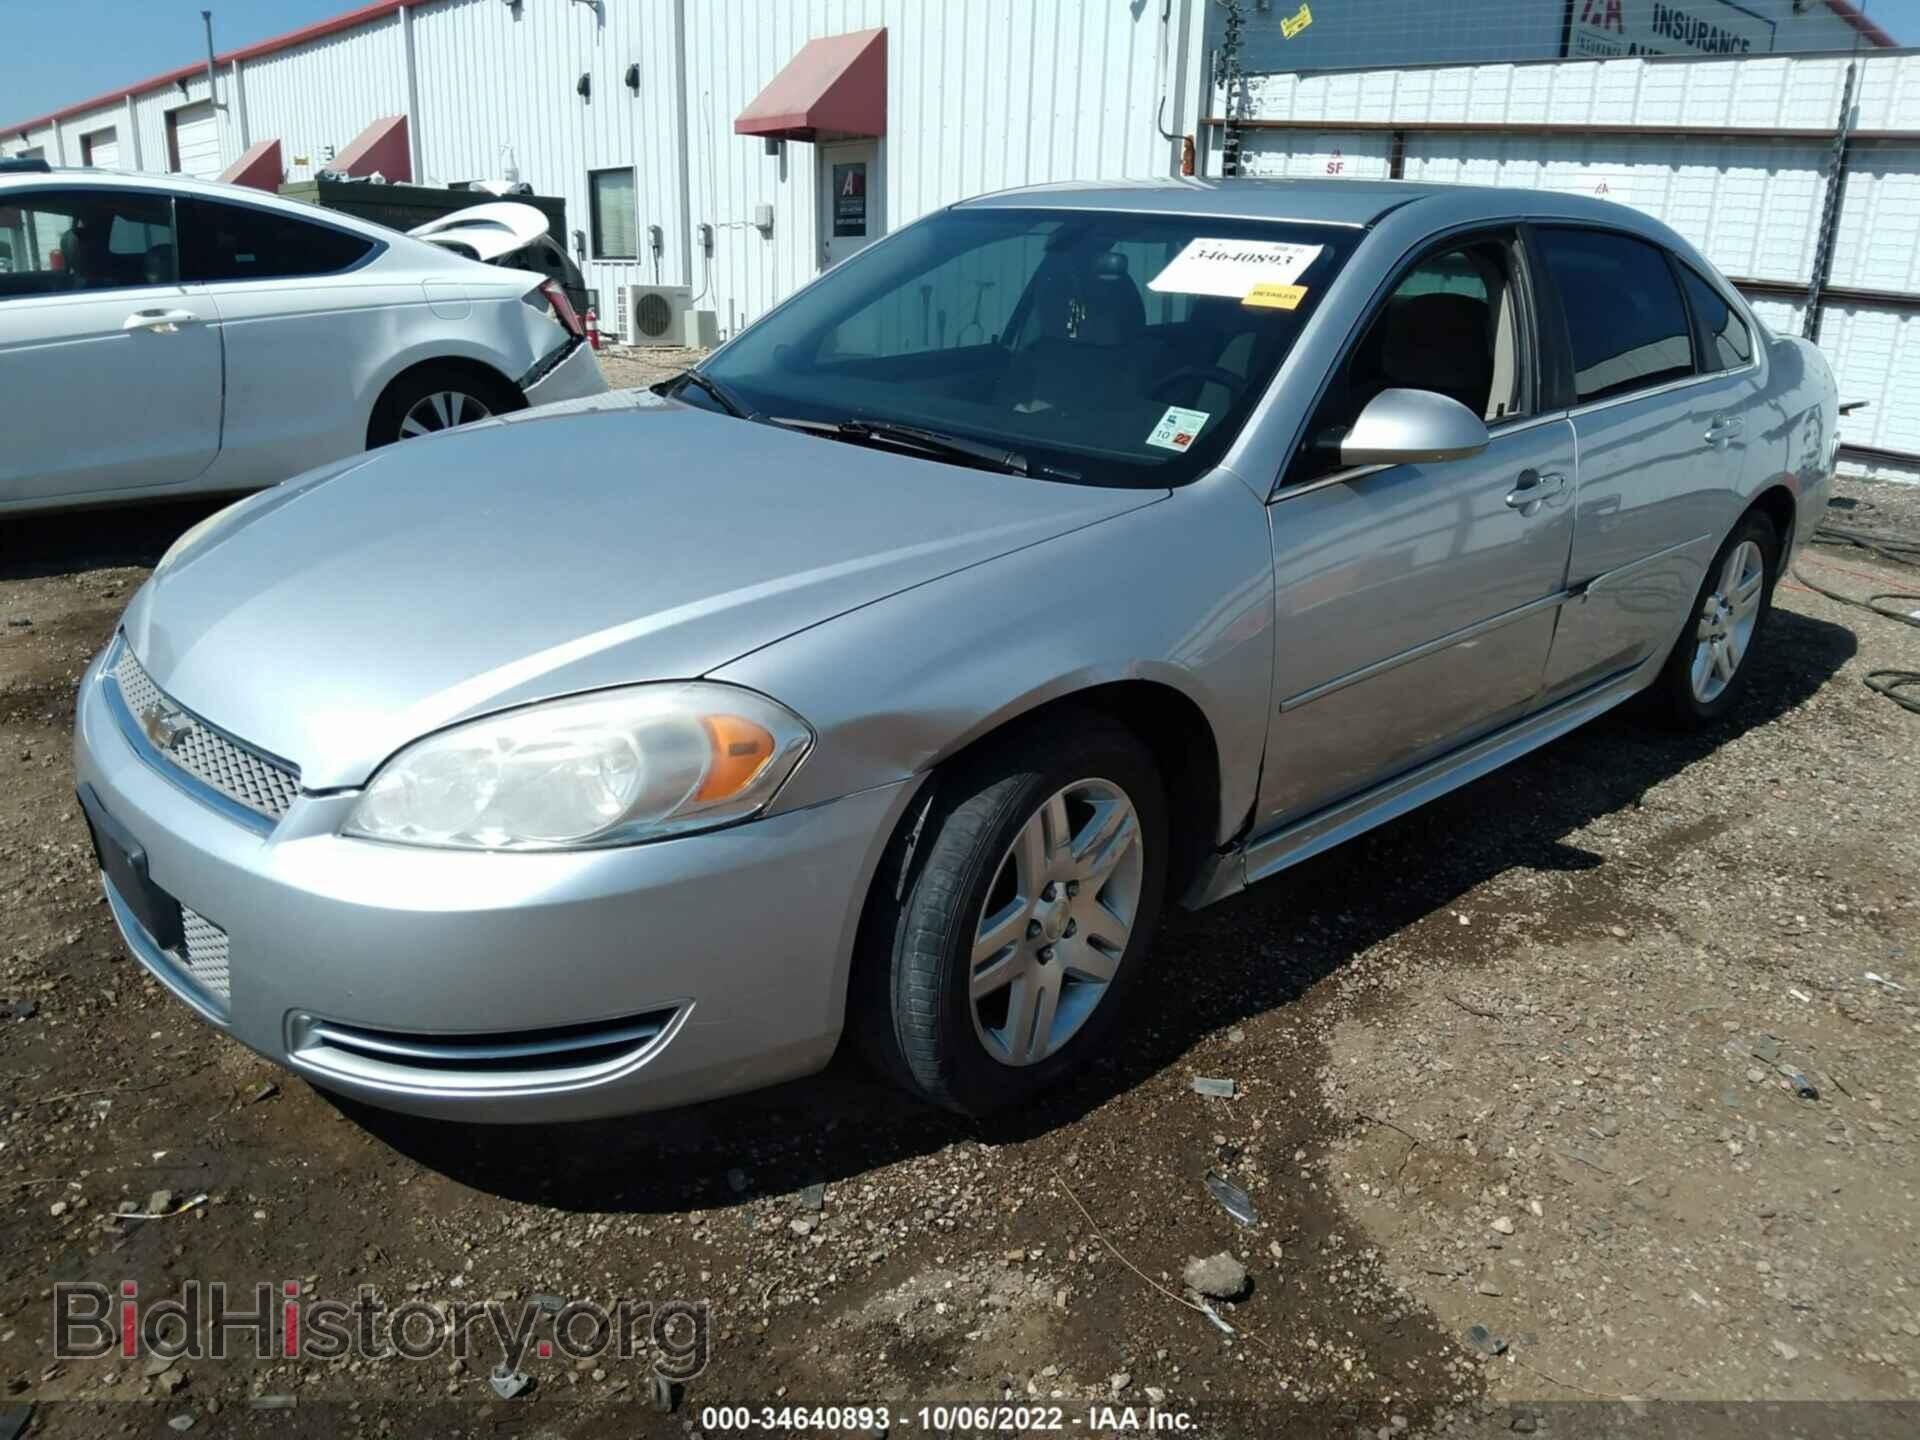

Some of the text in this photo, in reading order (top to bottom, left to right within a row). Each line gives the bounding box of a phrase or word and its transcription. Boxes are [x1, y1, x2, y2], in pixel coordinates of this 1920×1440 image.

[1327, 161, 1345, 174] SF
[1190, 249, 1294, 266] 34640893
[1157, 430, 1192, 446] 10 22
